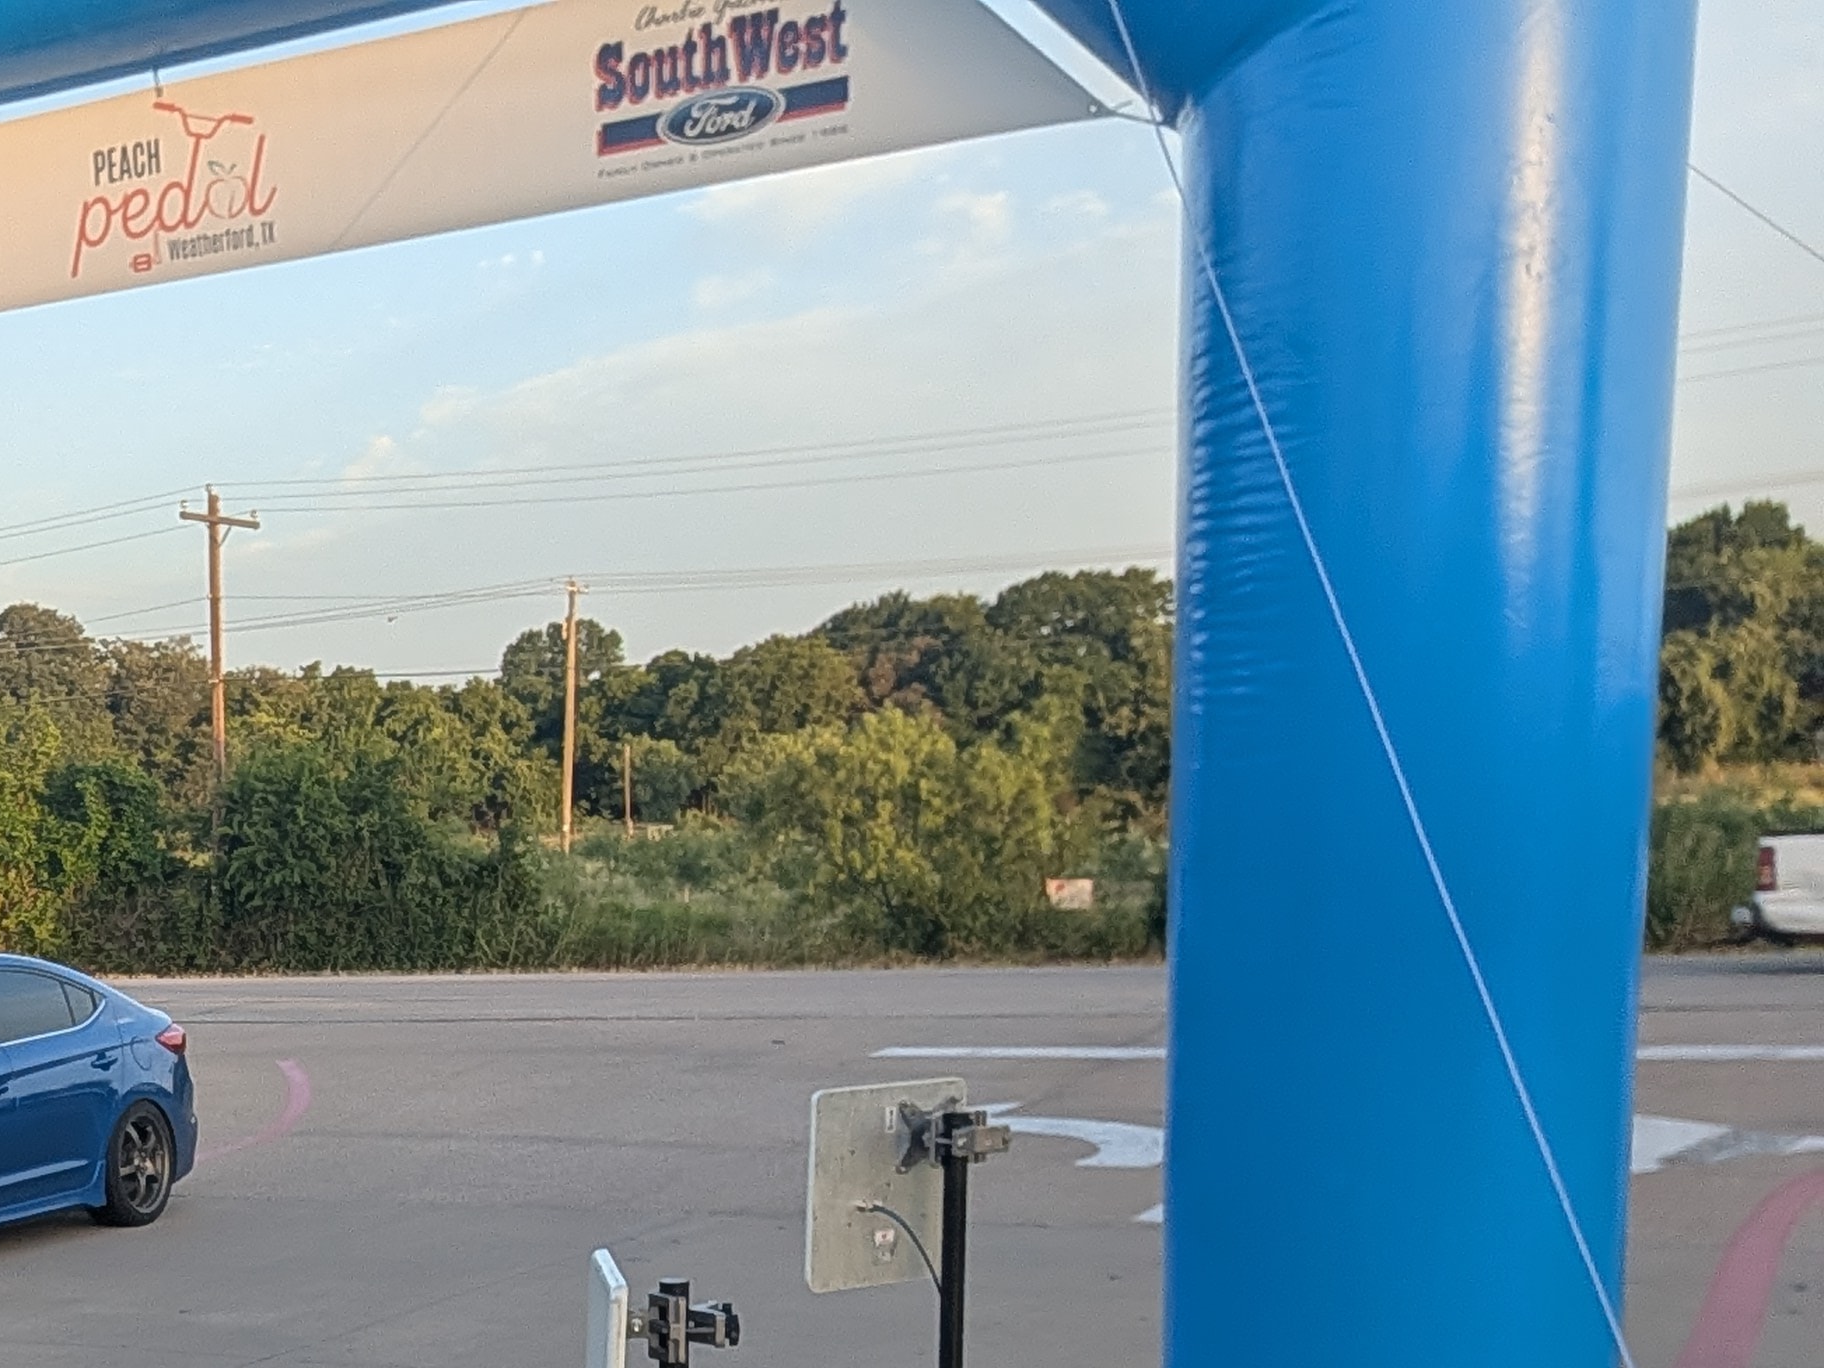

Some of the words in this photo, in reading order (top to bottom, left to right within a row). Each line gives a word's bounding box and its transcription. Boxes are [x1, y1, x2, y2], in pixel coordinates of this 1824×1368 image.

[683, 94, 757, 139] Ford
[93, 138, 162, 187] PEACH
[166, 223, 260, 261] Weatherford,
[261, 219, 277, 244] TX
